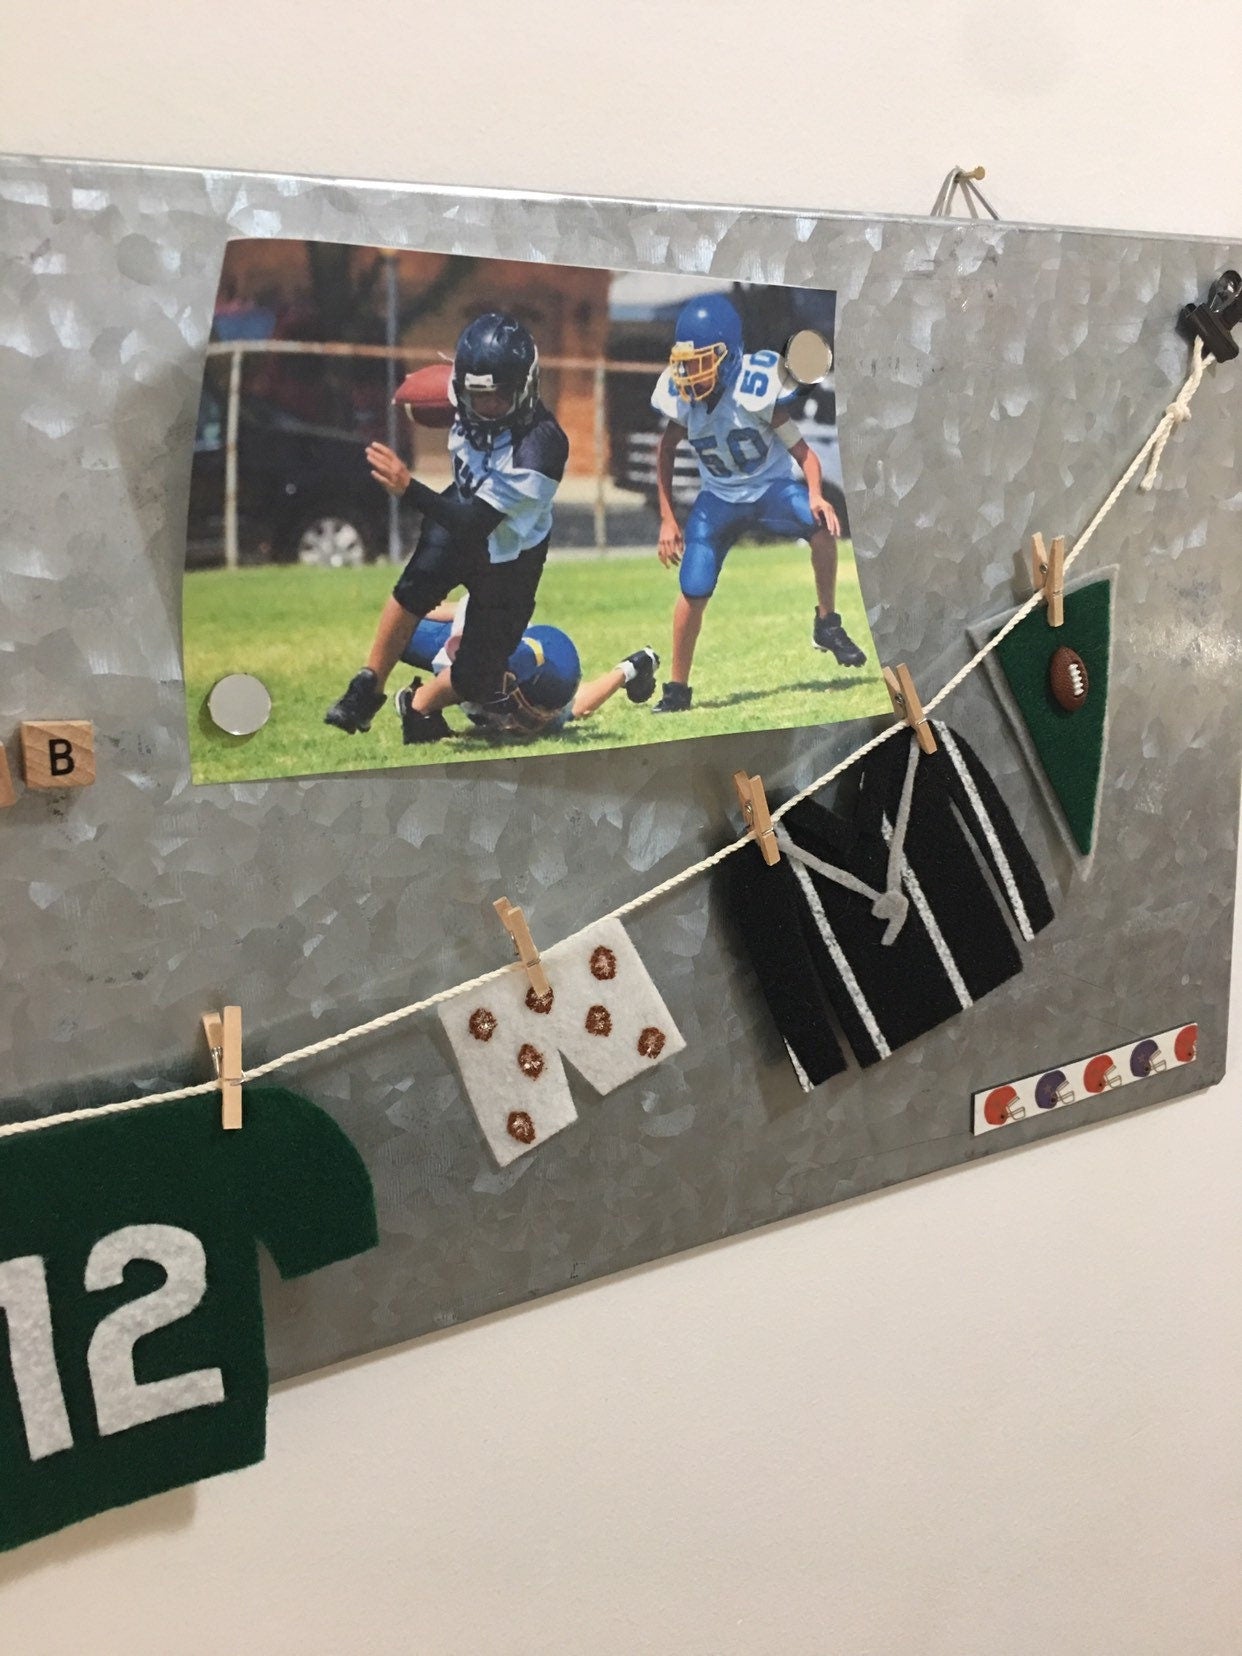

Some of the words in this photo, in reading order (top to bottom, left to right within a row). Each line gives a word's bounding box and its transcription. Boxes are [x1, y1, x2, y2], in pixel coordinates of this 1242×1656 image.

[740, 350, 778, 397] 50
[689, 427, 770, 478] 50
[49, 738, 75, 776] B
[0, 1223, 225, 1461] 12
